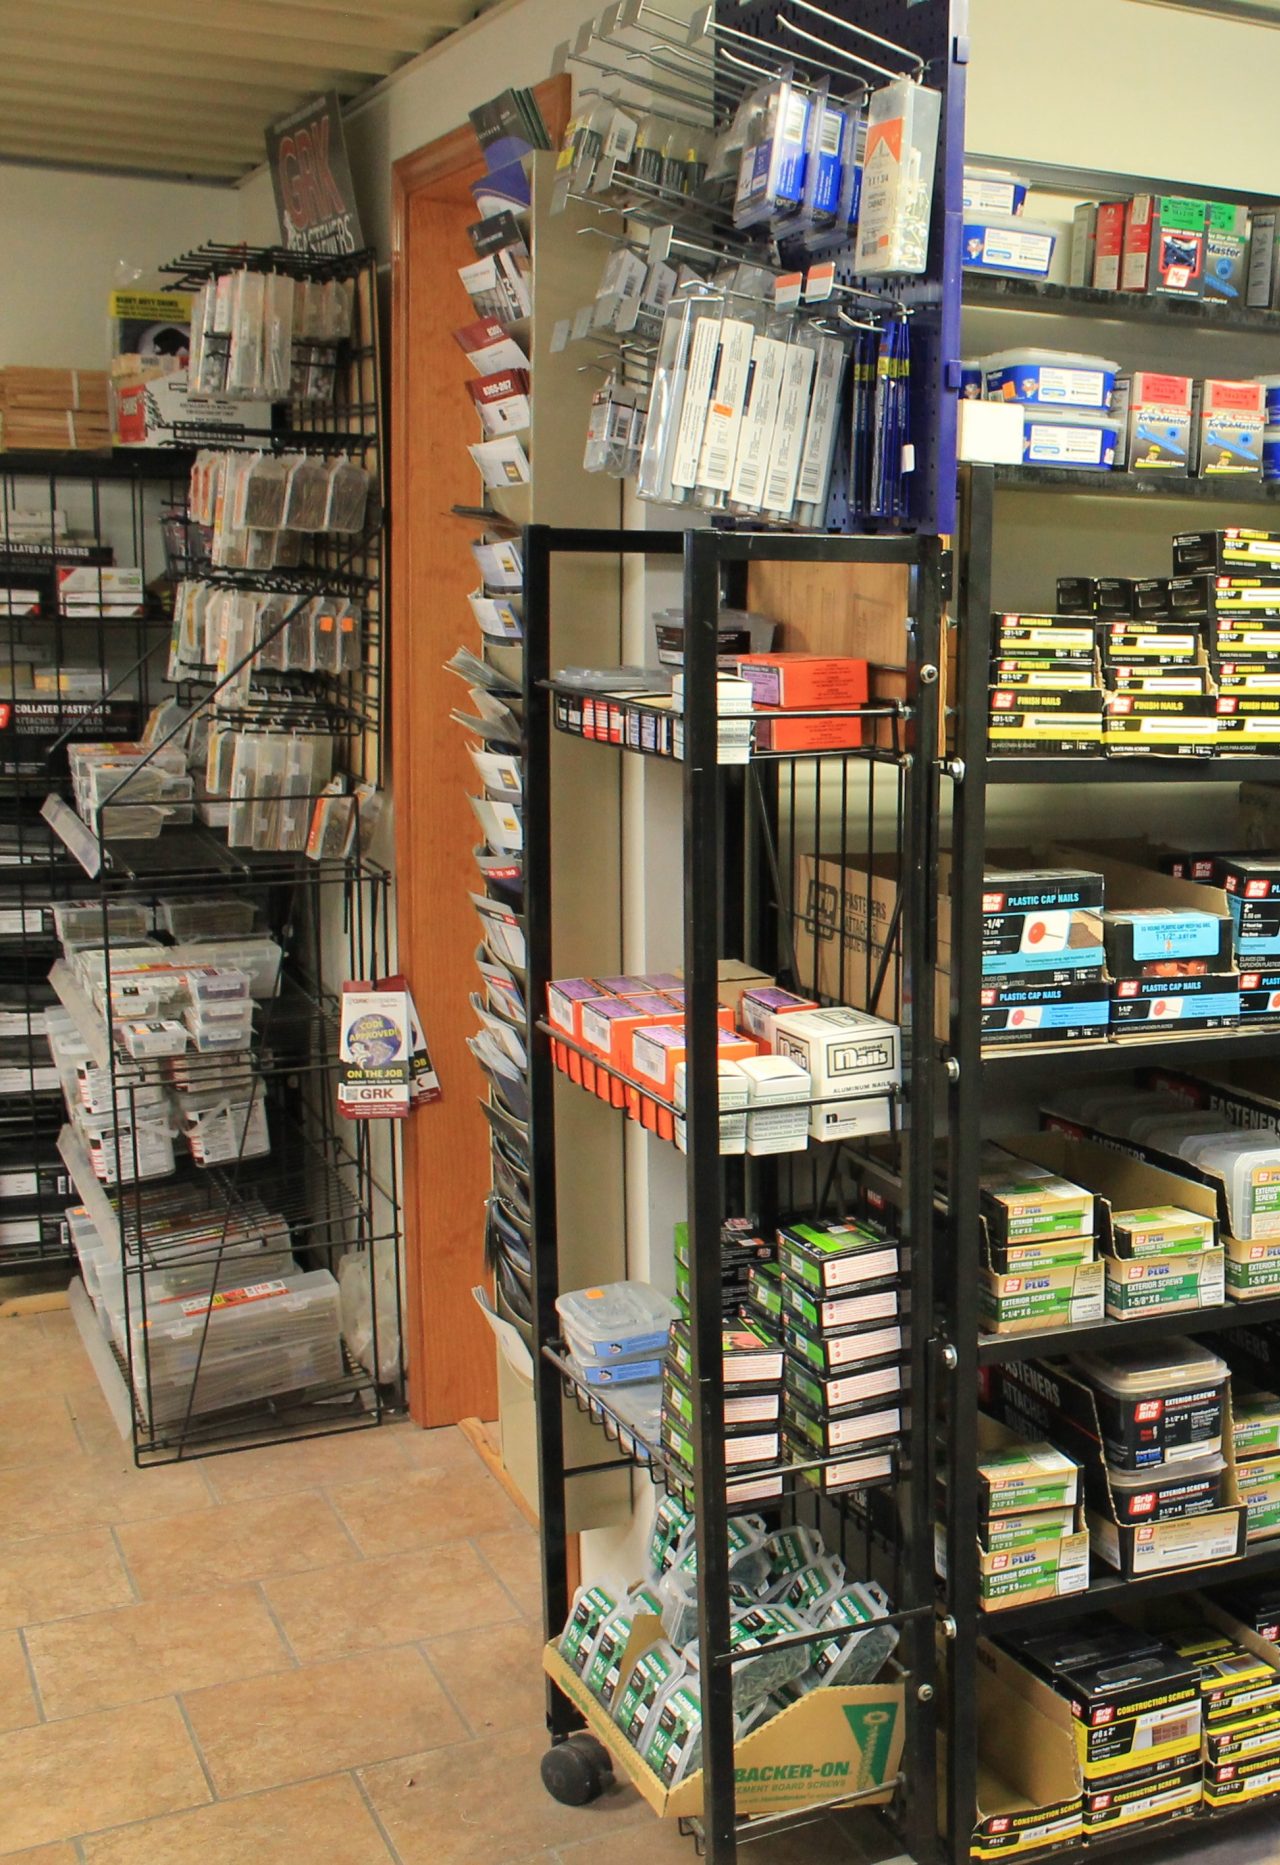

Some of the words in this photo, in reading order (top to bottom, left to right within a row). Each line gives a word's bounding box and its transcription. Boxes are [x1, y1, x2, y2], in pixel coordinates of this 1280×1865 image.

[1017, 697, 1040, 705] FINISH
[1041, 697, 1061, 706] NAILS
[1134, 701, 1158, 710] FINISH
[1160, 702, 1183, 711] NAILS
[1239, 702, 1259, 710] FINISH
[1261, 701, 1279, 710] NAILS
[1008, 895, 1039, 906] PLASTIC
[1041, 893, 1056, 904] CAP
[1058, 893, 1079, 903] NAILS
[1244, 903, 1253, 913] 2"
[1142, 983, 1168, 993] PLASTIC
[1169, 982, 1182, 991] CAP
[1183, 981, 1201, 990] NAILS
[1000, 992, 1027, 1002] PLASTIC
[1028, 992, 1041, 1000] CAP
[1042, 991, 1061, 1000] NAILS
[360, 1020, 383, 1029] CODE
[350, 1030, 398, 1041] APPROVED!
[385, 1069, 403, 1077] JOB
[833, 1084, 870, 1094] ALUMINUM
[872, 1081, 891, 1089] NAILS
[360, 1088, 394, 1099] GRK
[1255, 1185, 1280, 1195] EXTERIOR
[1255, 1193, 1278, 1202] SCREWS
[1147, 1266, 1170, 1276] PLUS
[1248, 1263, 1276, 1272] EXTERIOR
[1024, 1280, 1050, 1290] PLUS
[1127, 1282, 1156, 1292] EXTERIOR
[1157, 1277, 1183, 1287] SCREWS
[1248, 1275, 1267, 1285] 1-5/8"
[1268, 1274, 1273, 1282] X
[1001, 1296, 1029, 1306] EXTERIOR
[1030, 1293, 1055, 1303] SCREWS
[1127, 1295, 1147, 1306] 1-5/8"
[1148, 1295, 1154, 1303] X
[1001, 1309, 1019, 1319] 1-1/4"
[1165, 1396, 1191, 1406] EXTERIOR
[1192, 1390, 1215, 1400] SCREWS
[1138, 1402, 1159, 1411] Grip
[1136, 1410, 1157, 1420] Rite
[1159, 1488, 1184, 1497] EXTERIOR
[1185, 1482, 1209, 1491] SCREWS
[1133, 1495, 1152, 1504] Grip
[1131, 1502, 1151, 1513] Rite
[1257, 1503, 1280, 1513] SCREWS
[1012, 1553, 1036, 1565] PLUS
[989, 1573, 1017, 1584] EXTERIOR
[1018, 1566, 1042, 1578] SCREWS
[989, 1585, 1007, 1595] 2-1/2"
[589, 1589, 612, 1613] BACKER-ON
[645, 1654, 667, 1681] BACKER-ON
[1117, 1696, 1167, 1716] CONSTRUCTION
[1168, 1688, 1195, 1702] SCREWS
[1095, 1708, 1113, 1718] Grip
[1093, 1715, 1111, 1725] Rite
[734, 1760, 850, 1784] BACKER-ON
[1238, 1759, 1278, 1775] CONSTRUCTION
[770, 1782, 804, 1791] BOARD
[806, 1778, 846, 1789] SCREWS
[1113, 1783, 1157, 1803] CONSTRUCTION
[1157, 1777, 1181, 1791] SCREWS
[1013, 1808, 1059, 1827] CONSTRUCTION
[1059, 1801, 1082, 1815] SCREWS
